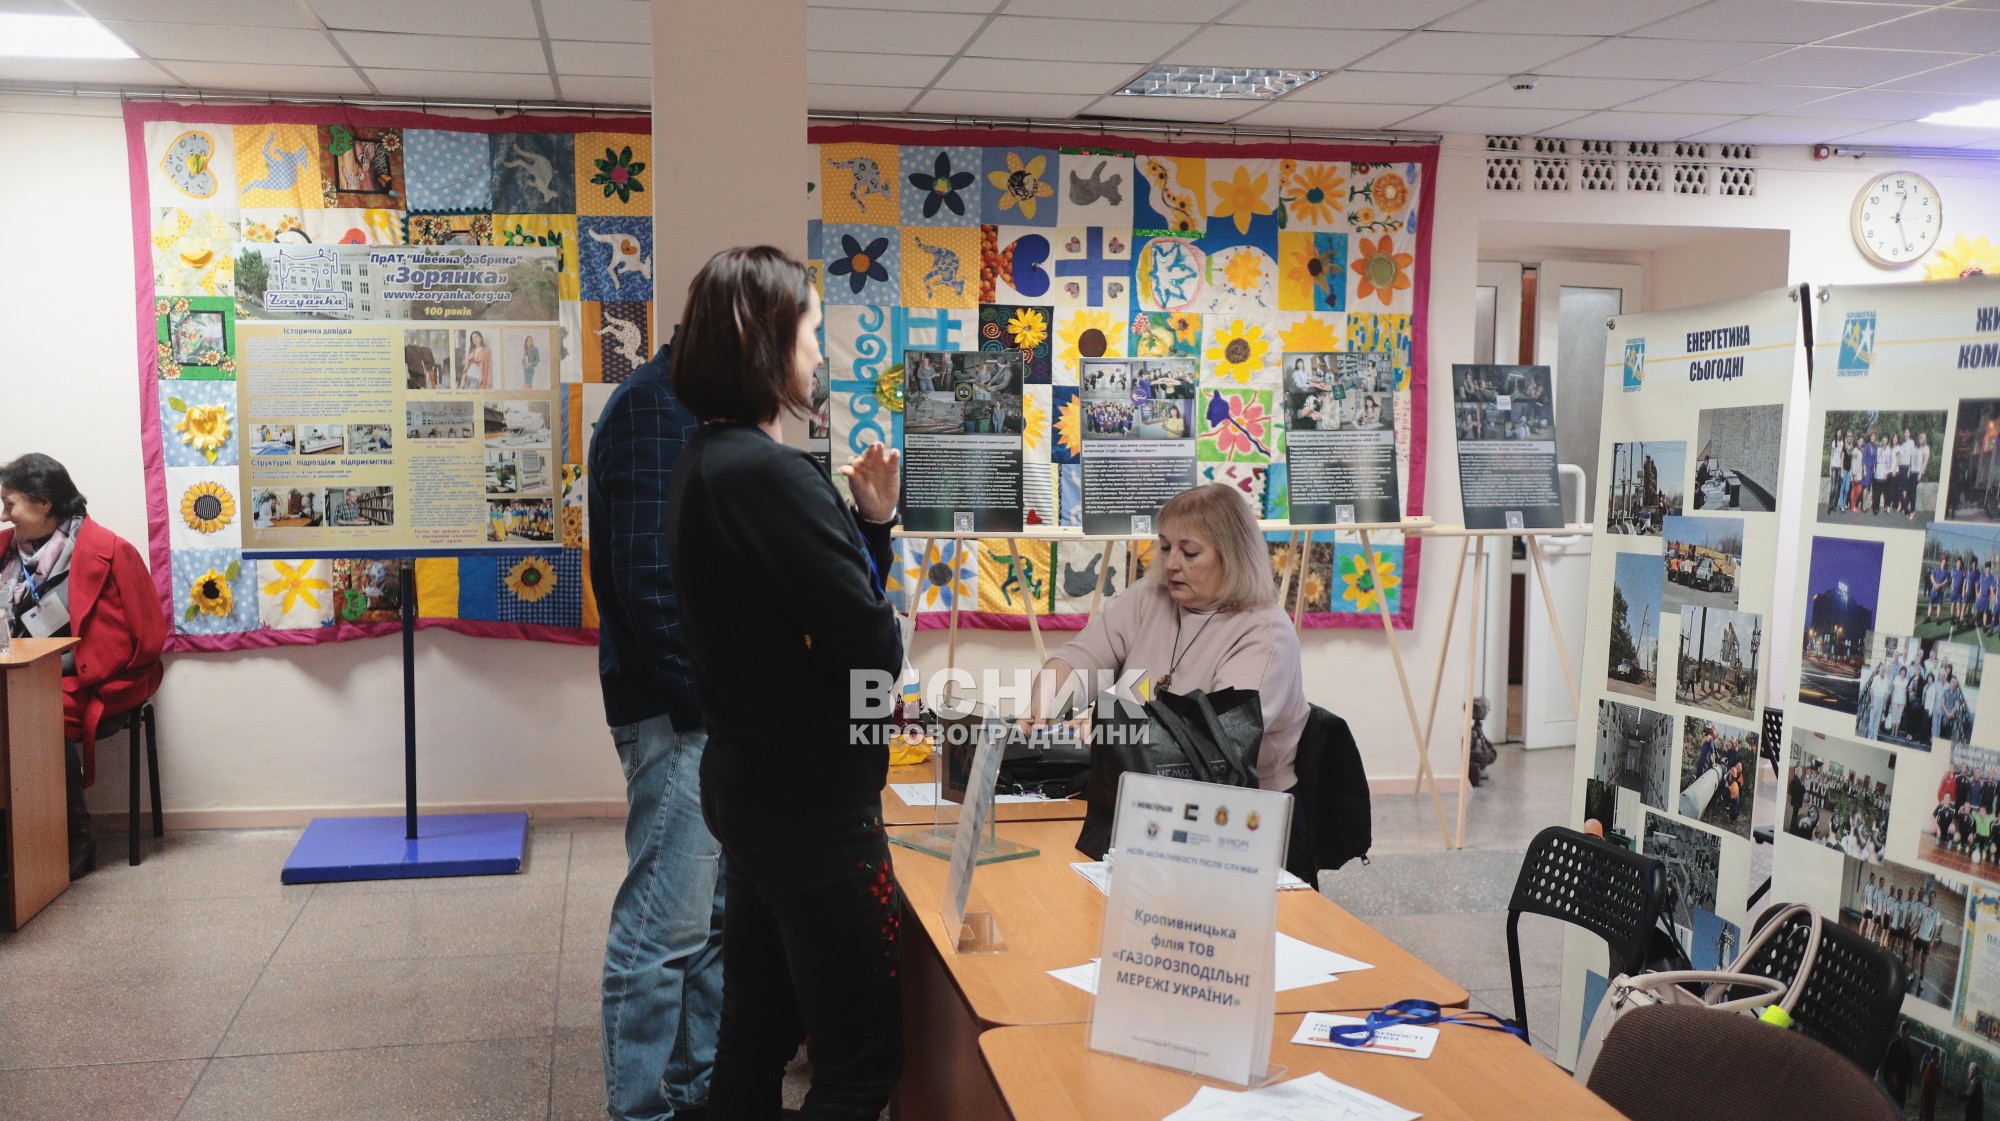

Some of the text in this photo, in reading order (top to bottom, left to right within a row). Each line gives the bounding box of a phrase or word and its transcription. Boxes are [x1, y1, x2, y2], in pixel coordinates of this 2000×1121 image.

[1881, 184, 1889, 192] 11
[1896, 180, 1905, 188] 12
[1913, 185, 1918, 193] 1
[1870, 196, 1879, 205] 10
[1864, 213, 1870, 221] 9
[1925, 215, 1932, 223] 3
[1867, 230, 1874, 238] 8
[1920, 231, 1926, 239] 4
[1878, 242, 1884, 250] 7
[1908, 243, 1914, 251] 5
[1892, 247, 1898, 255] 6
[370, 253, 404, 264] ПрАТ
[385, 266, 508, 288] «Зорянка»
[383, 289, 512, 302] www.zoryanka.org.ua
[269, 294, 344, 307] Zoryanka
[424, 306, 472, 317] 100 років
[283, 327, 352, 336] Історична довідка
[1686, 325, 1751, 353] ЕНЕРГЕТИКА
[1689, 357, 1745, 381] СЬОГОДНІ
[251, 459, 292, 467] Структурні
[341, 458, 395, 466] підприємства:
[1126, 847, 1259, 874] НОВІ МОЖЛИВОСТІ ПІСЛЯ СЛУЖБИ
[1134, 909, 1237, 939] Кропивницька
[1151, 934, 1215, 957] філія ТОВ
[1112, 949, 1250, 987] «ГАЗОРОЗПОДІЛЬНІ
[1116, 970, 1240, 1006] МЕРЕЖІ УКРАЇНИ»
